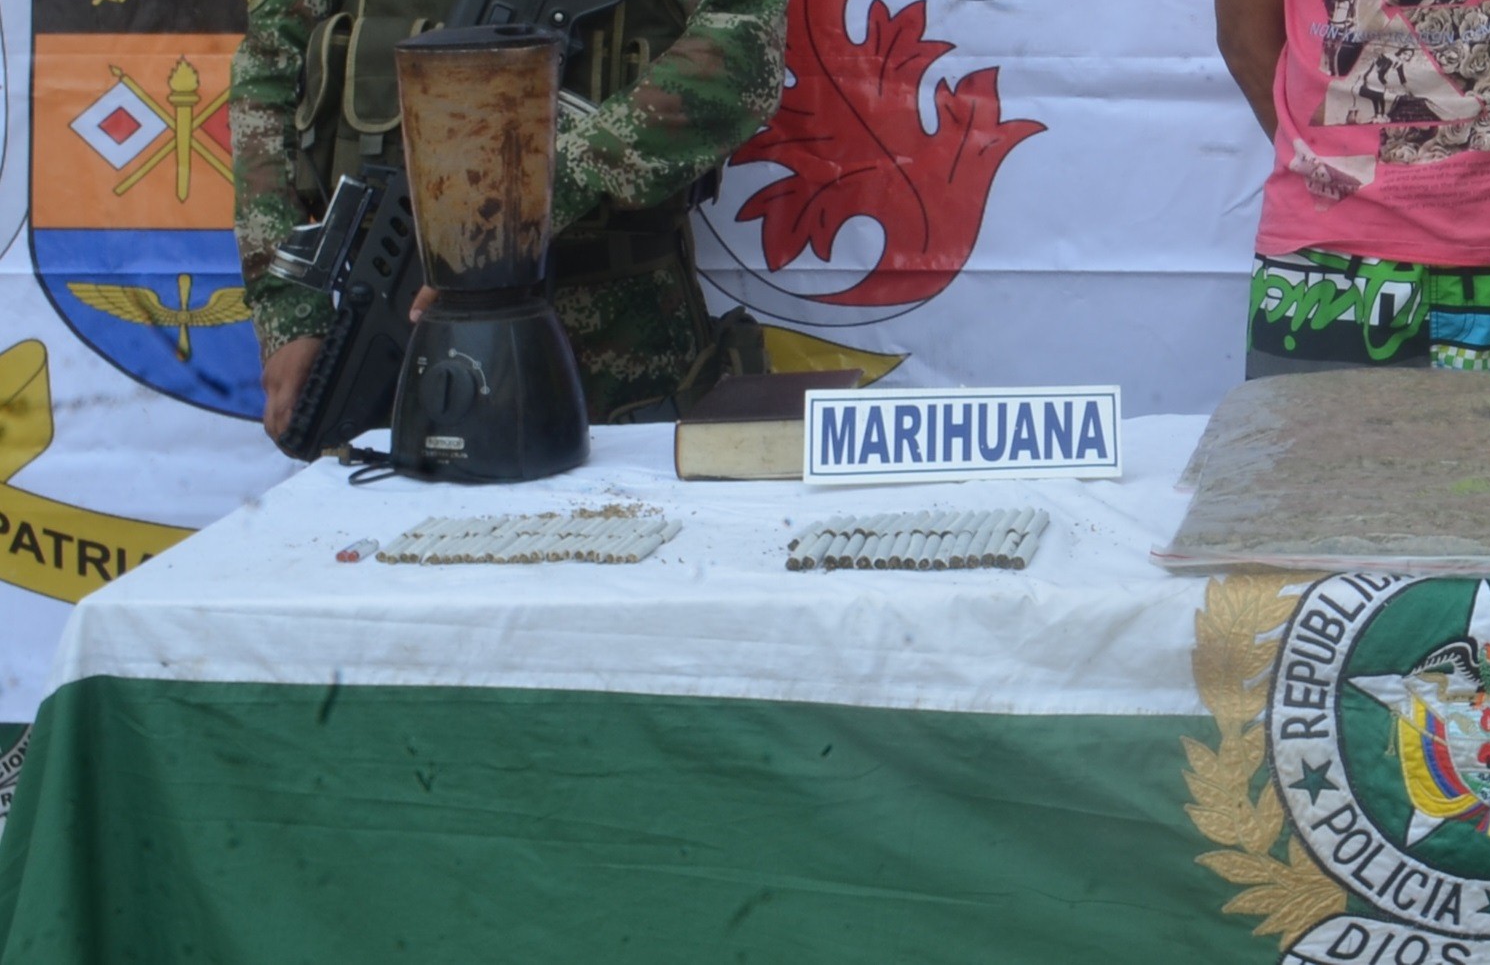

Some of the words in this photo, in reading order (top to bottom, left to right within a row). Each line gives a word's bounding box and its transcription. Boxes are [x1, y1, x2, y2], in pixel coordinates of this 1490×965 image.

[821, 400, 1108, 465] MARIHUANA
[0, 512, 155, 582] ATRI
[1281, 573, 1415, 740] REPUBLIC
[1310, 802, 1464, 926] POLICIA
